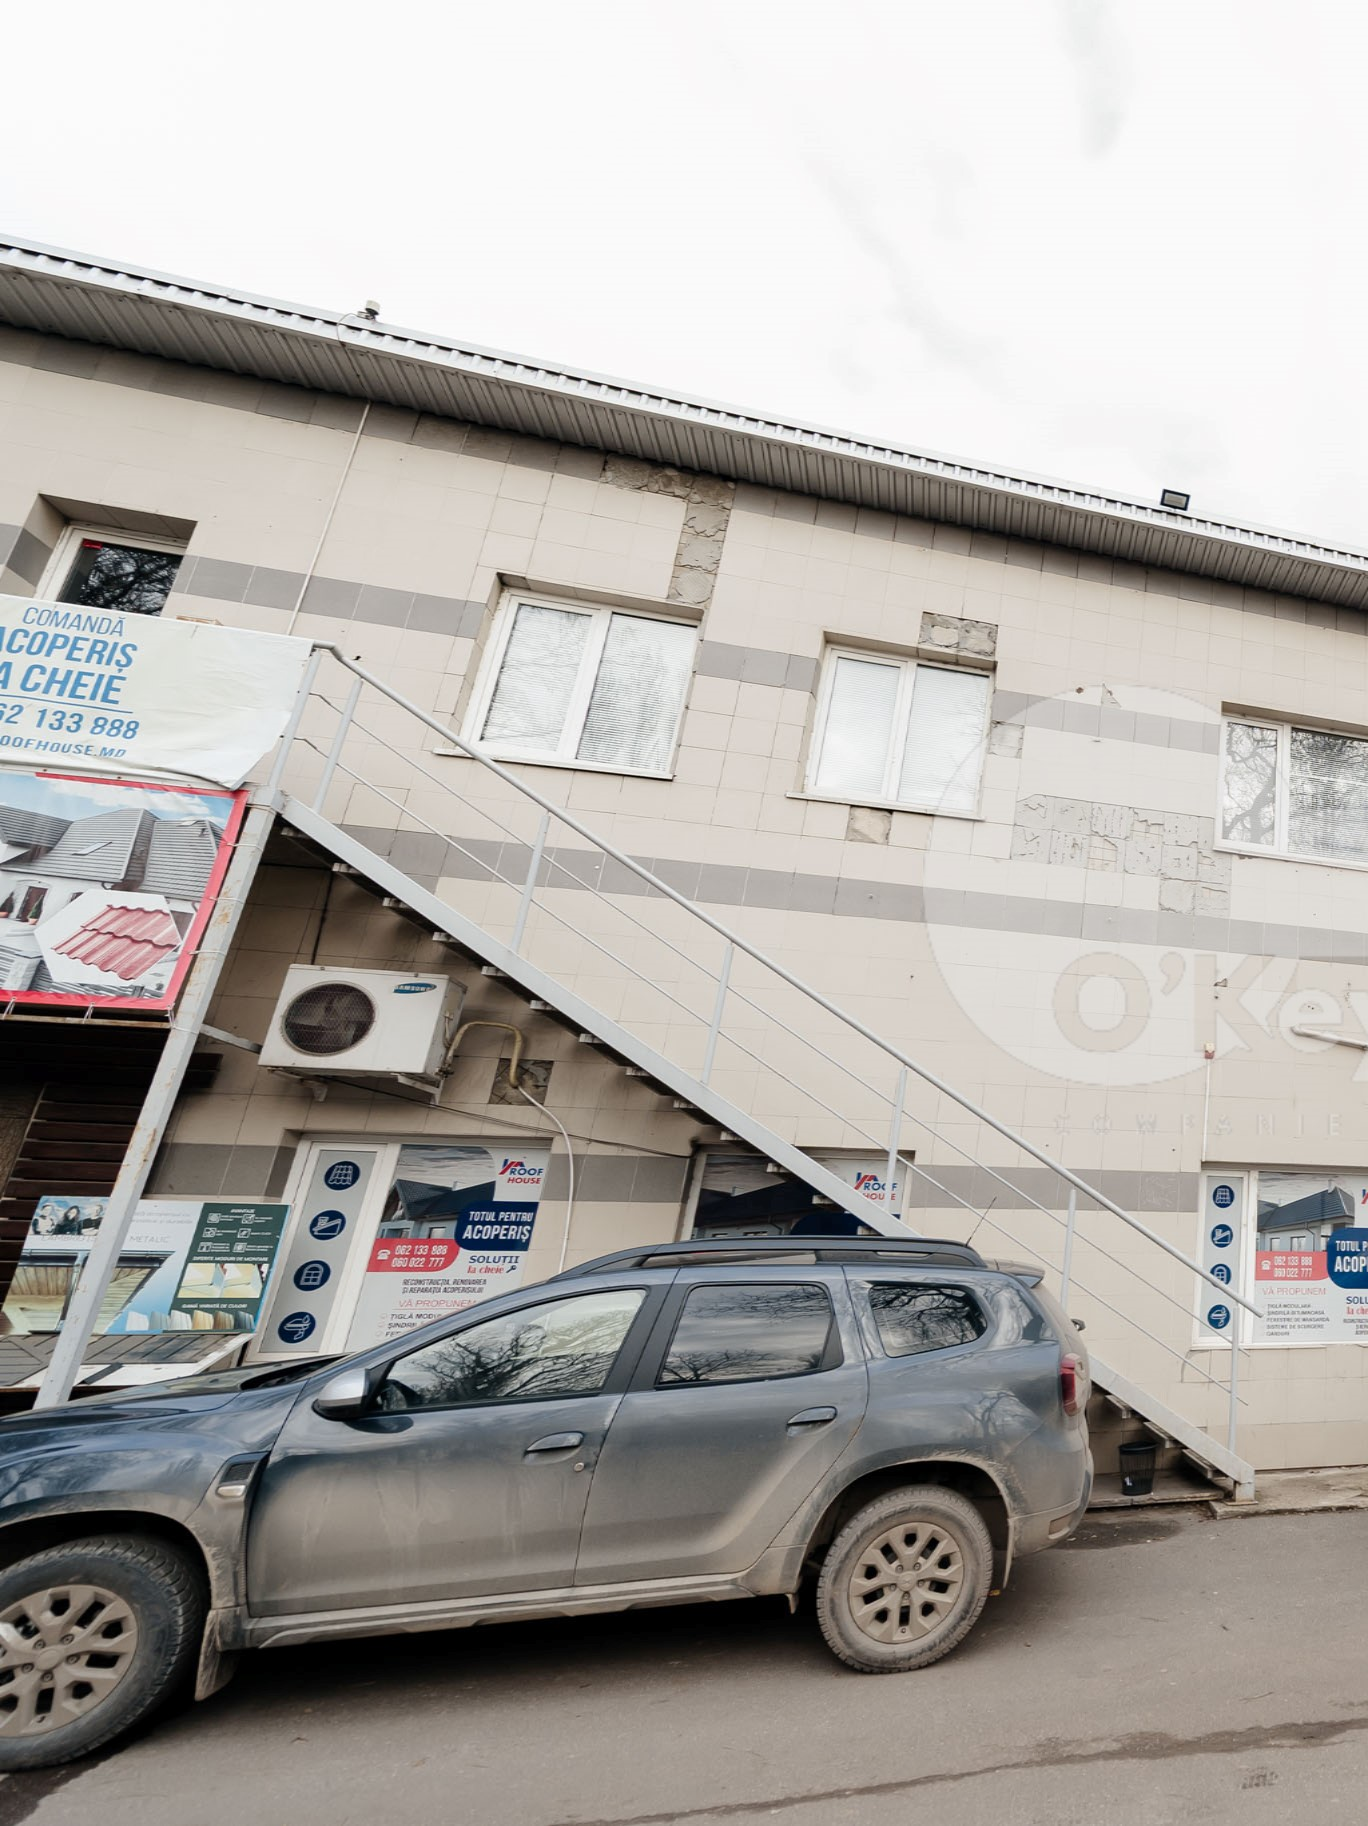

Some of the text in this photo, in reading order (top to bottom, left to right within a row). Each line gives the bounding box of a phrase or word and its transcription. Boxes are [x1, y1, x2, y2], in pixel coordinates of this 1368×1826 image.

[22, 607, 126, 637] COMANDĂ
[20, 664, 127, 705] CHEIE
[36, 708, 84, 734] 133
[90, 717, 140, 740] 888
[510, 1168, 544, 1176] ROOF
[507, 1177, 542, 1185] HOUSE
[469, 1211, 534, 1222] TOTUL PENTRU
[462, 1225, 531, 1242] ACOPERIȘ
[1335, 1240, 1360, 1252] TOTUL
[429, 1257, 445, 1267] 777
[467, 1265, 504, 1274] la cheie
[1276, 1287, 1326, 1296] PROPUNEM
